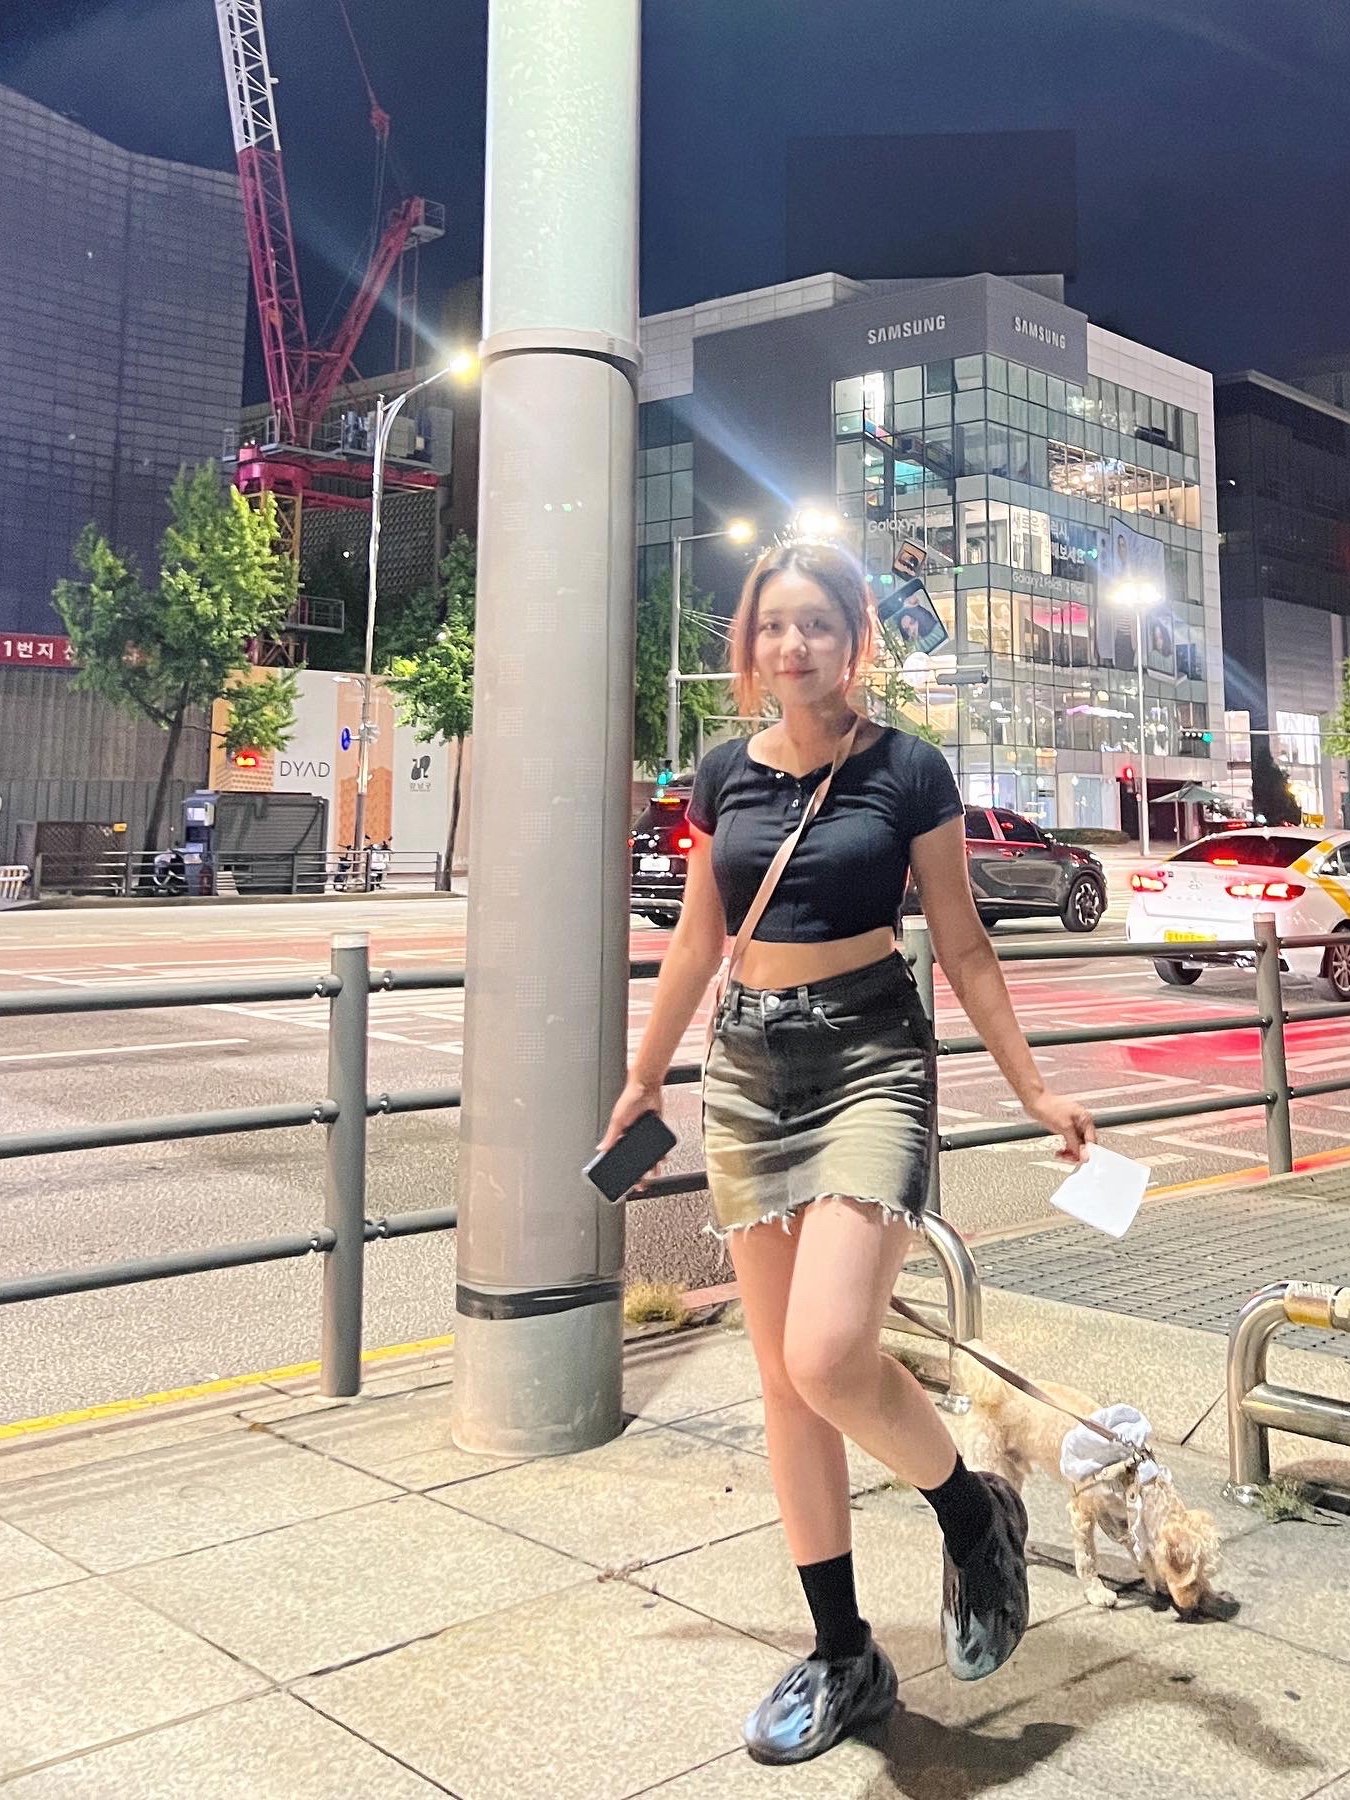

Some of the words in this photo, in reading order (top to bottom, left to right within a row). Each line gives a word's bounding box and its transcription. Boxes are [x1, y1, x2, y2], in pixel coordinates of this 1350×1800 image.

[867, 315, 946, 345] SAMSUNG
[1014, 316, 1066, 349] SAMSUNG
[868, 518, 910, 534] Galaxy
[1012, 571, 1037, 588] Galaxy
[3, 640, 53, 659] 1번지
[280, 760, 331, 778] DYAD
